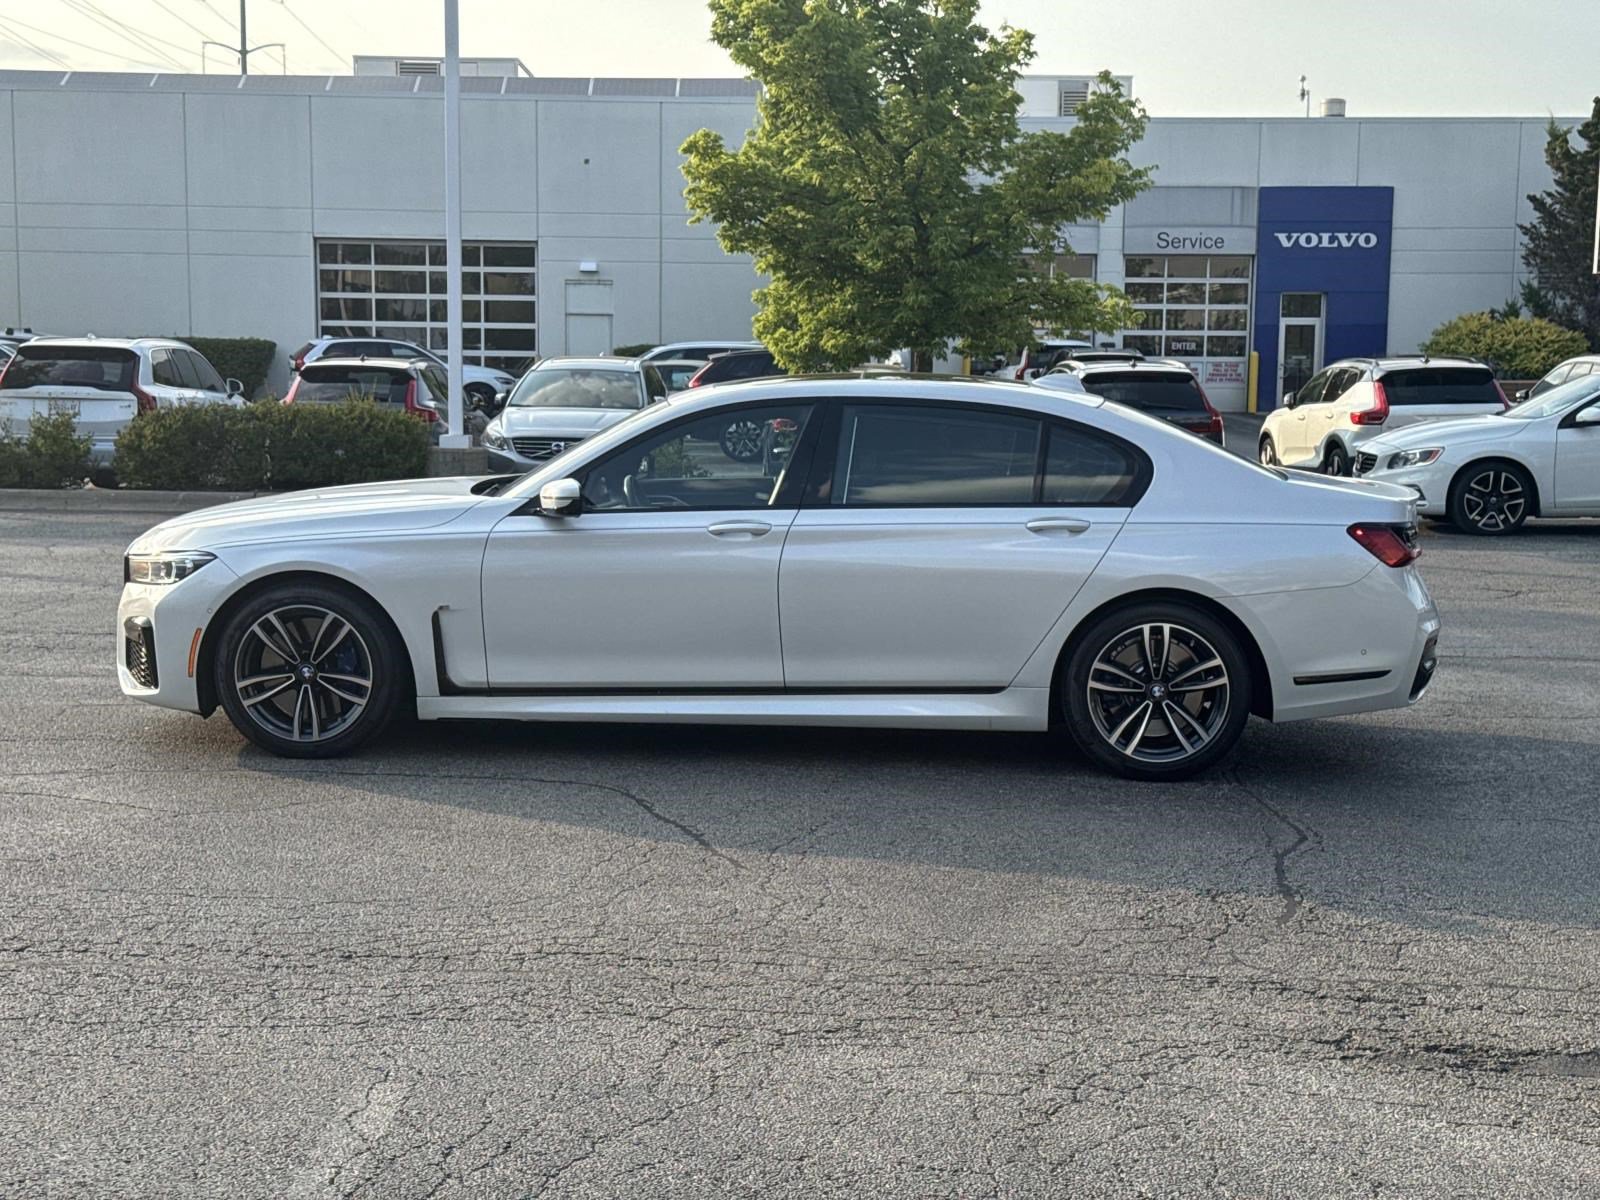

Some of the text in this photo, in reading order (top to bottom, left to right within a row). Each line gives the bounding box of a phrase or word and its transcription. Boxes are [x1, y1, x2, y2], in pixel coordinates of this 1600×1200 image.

[1156, 232, 1225, 250] Service
[1274, 232, 1378, 248] VOLVO
[1171, 342, 1197, 351] ENTER
